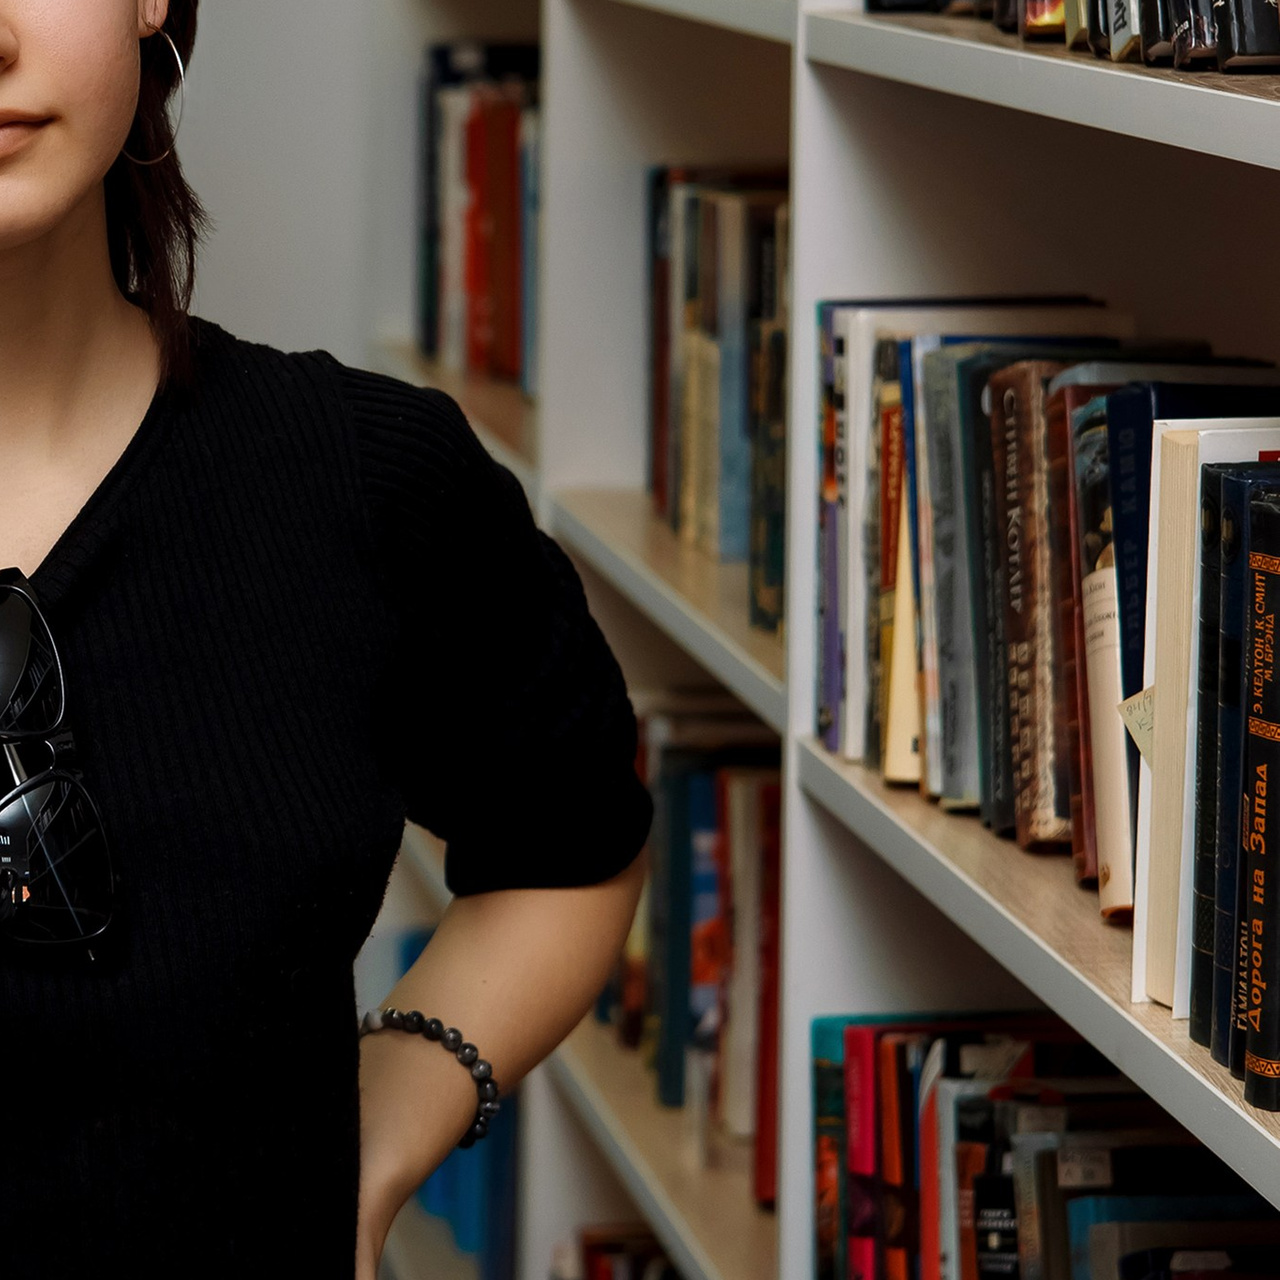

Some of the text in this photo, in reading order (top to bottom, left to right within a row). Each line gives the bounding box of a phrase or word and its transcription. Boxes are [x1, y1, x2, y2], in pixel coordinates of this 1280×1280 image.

[1253, 572, 1266, 613] СМИТ
[1251, 636, 1265, 697] КЕЛТОН
[1263, 613, 1275, 682] М. БРЭНД
[1248, 762, 1268, 1032] Дорога на Запад
